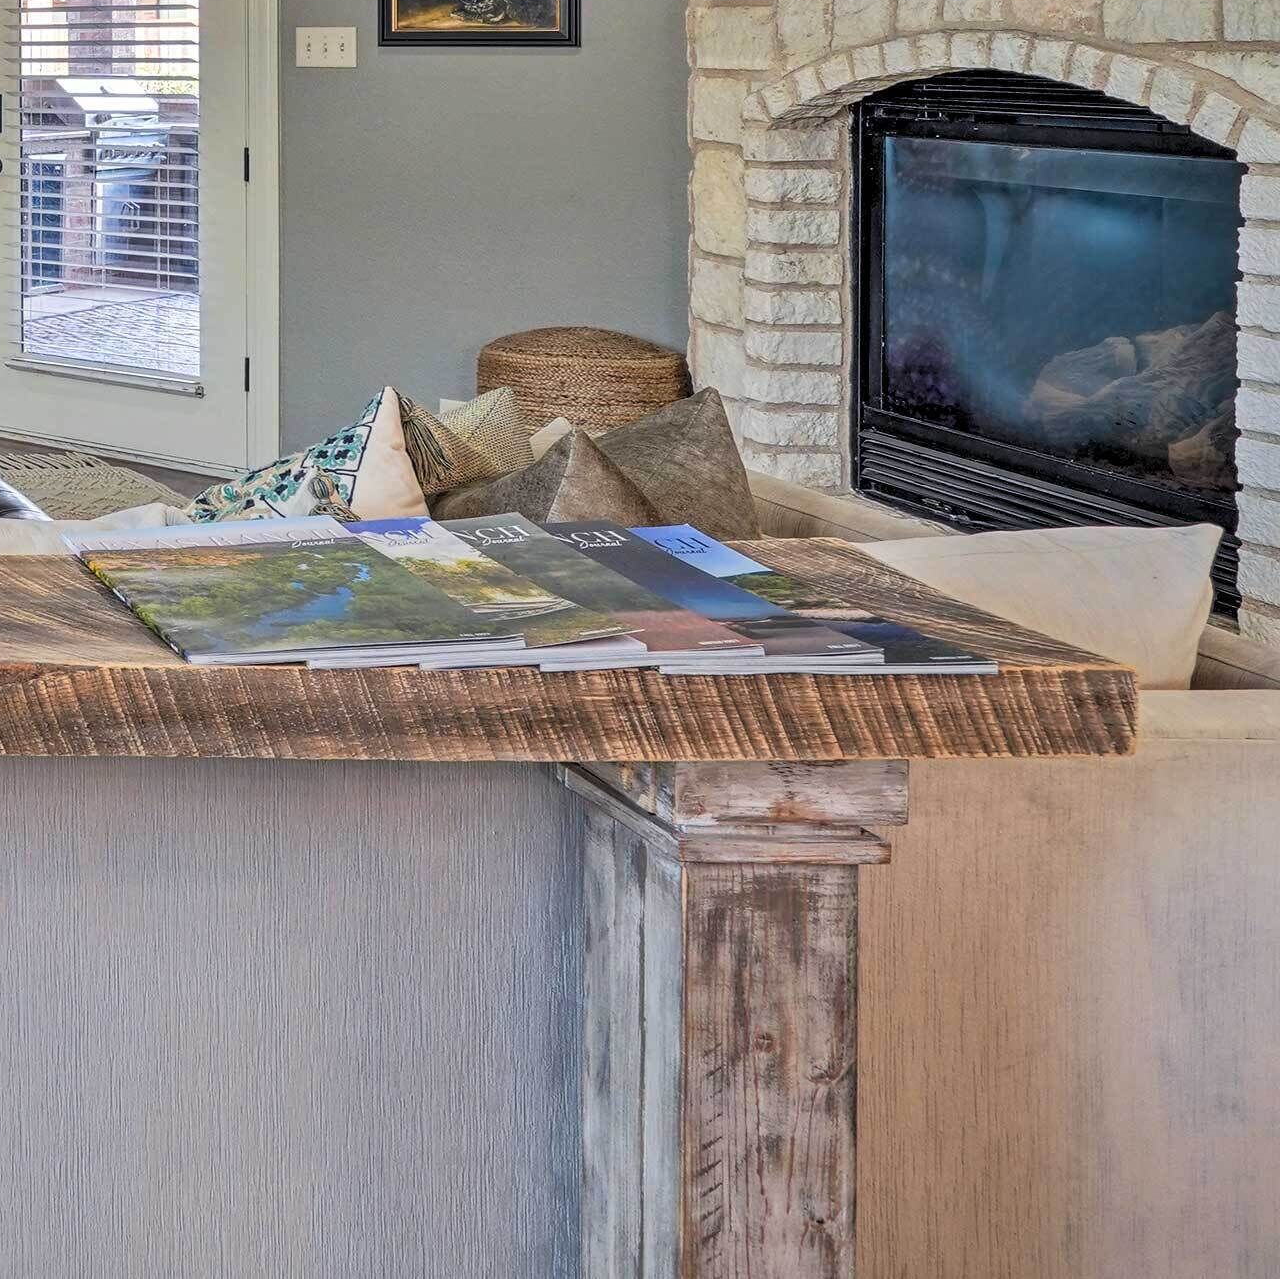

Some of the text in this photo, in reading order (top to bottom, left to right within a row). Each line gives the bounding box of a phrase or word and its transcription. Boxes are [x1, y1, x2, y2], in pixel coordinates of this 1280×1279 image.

[291, 537, 337, 549] Journal
[481, 535, 527, 547] Journal
[579, 539, 623, 550] Journal
